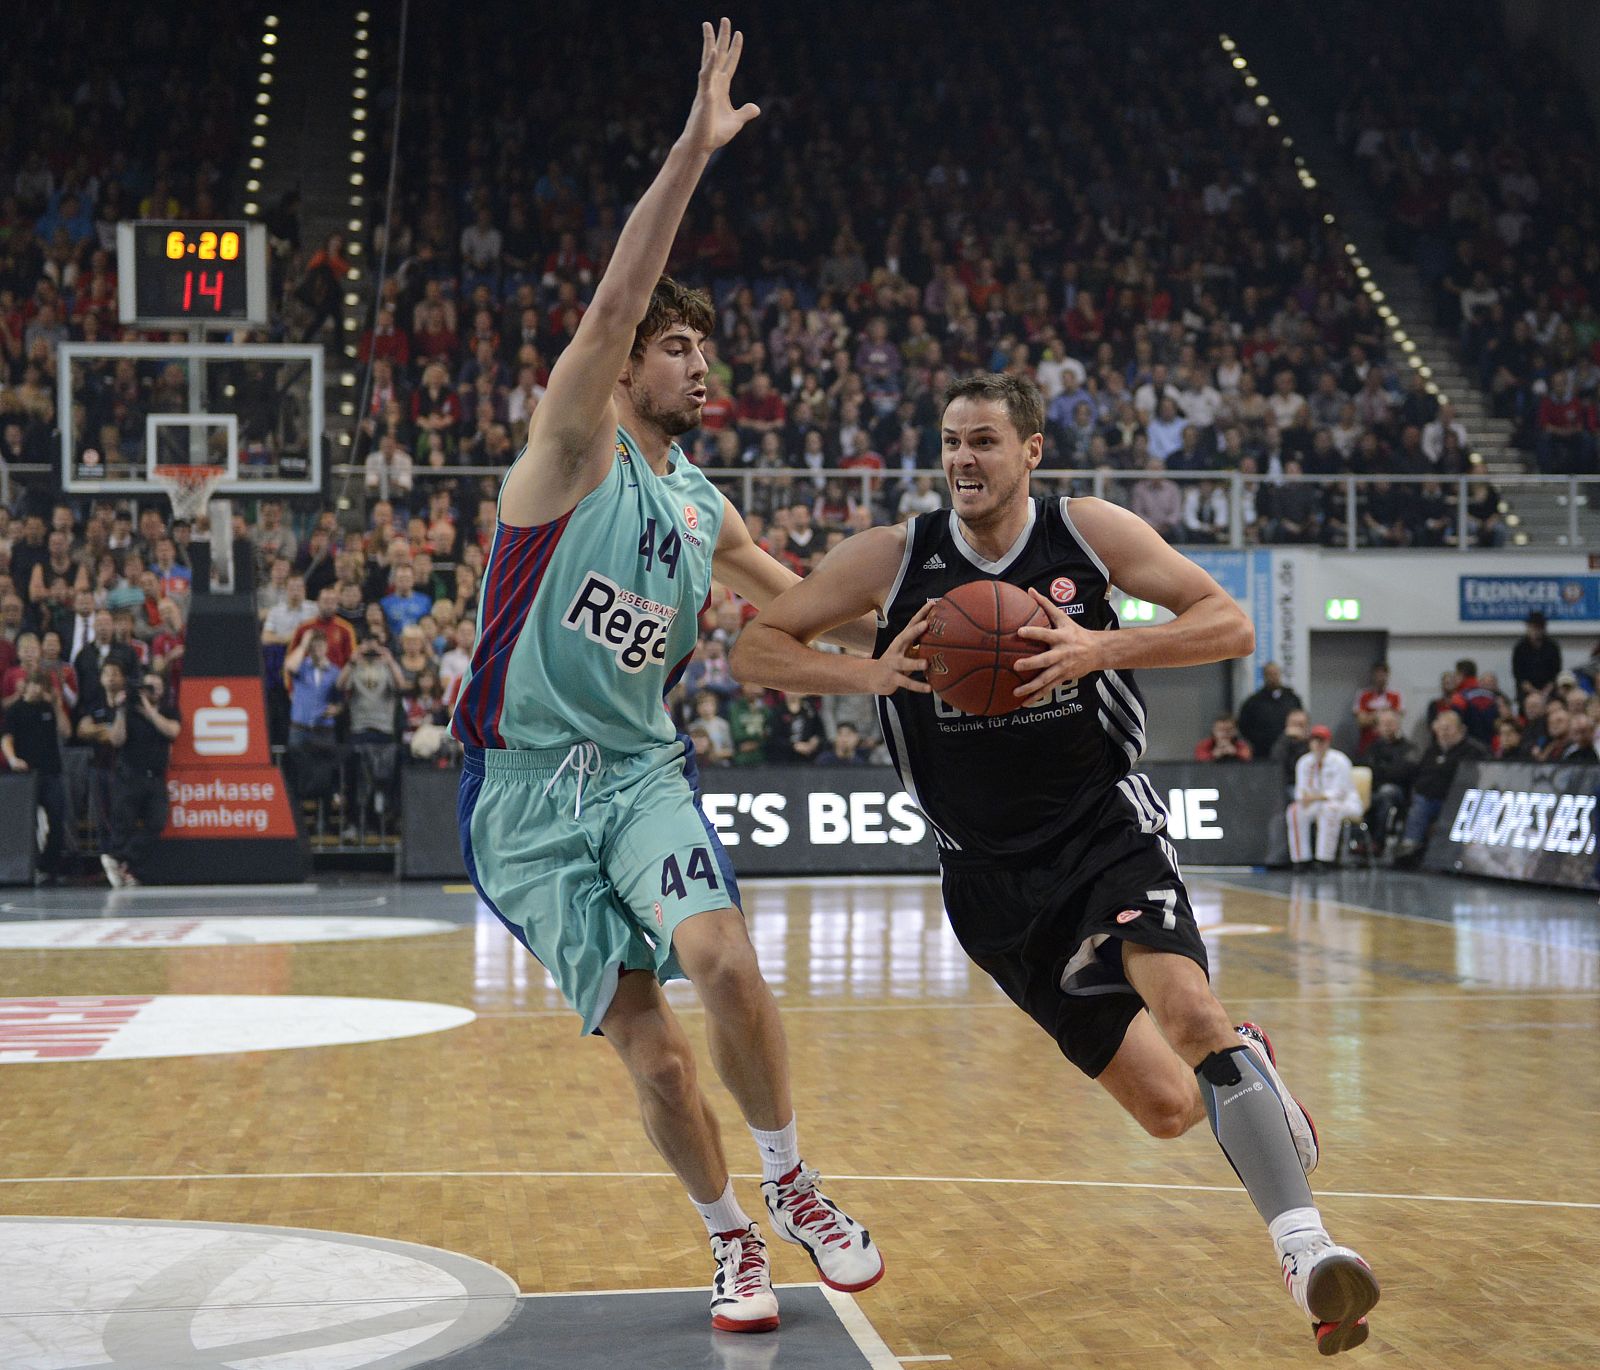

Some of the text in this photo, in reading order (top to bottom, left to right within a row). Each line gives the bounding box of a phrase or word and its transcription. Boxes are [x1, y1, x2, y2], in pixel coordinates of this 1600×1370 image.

[183, 271, 224, 312] 14
[639, 518, 681, 579] 44
[923, 562, 946, 570] adidas
[937, 702, 1083, 733] Technik für Automobile
[167, 779, 275, 805] Sparkasse
[172, 805, 269, 832] Bamberg
[661, 848, 719, 900] 44
[1146, 889, 1177, 930] 7
